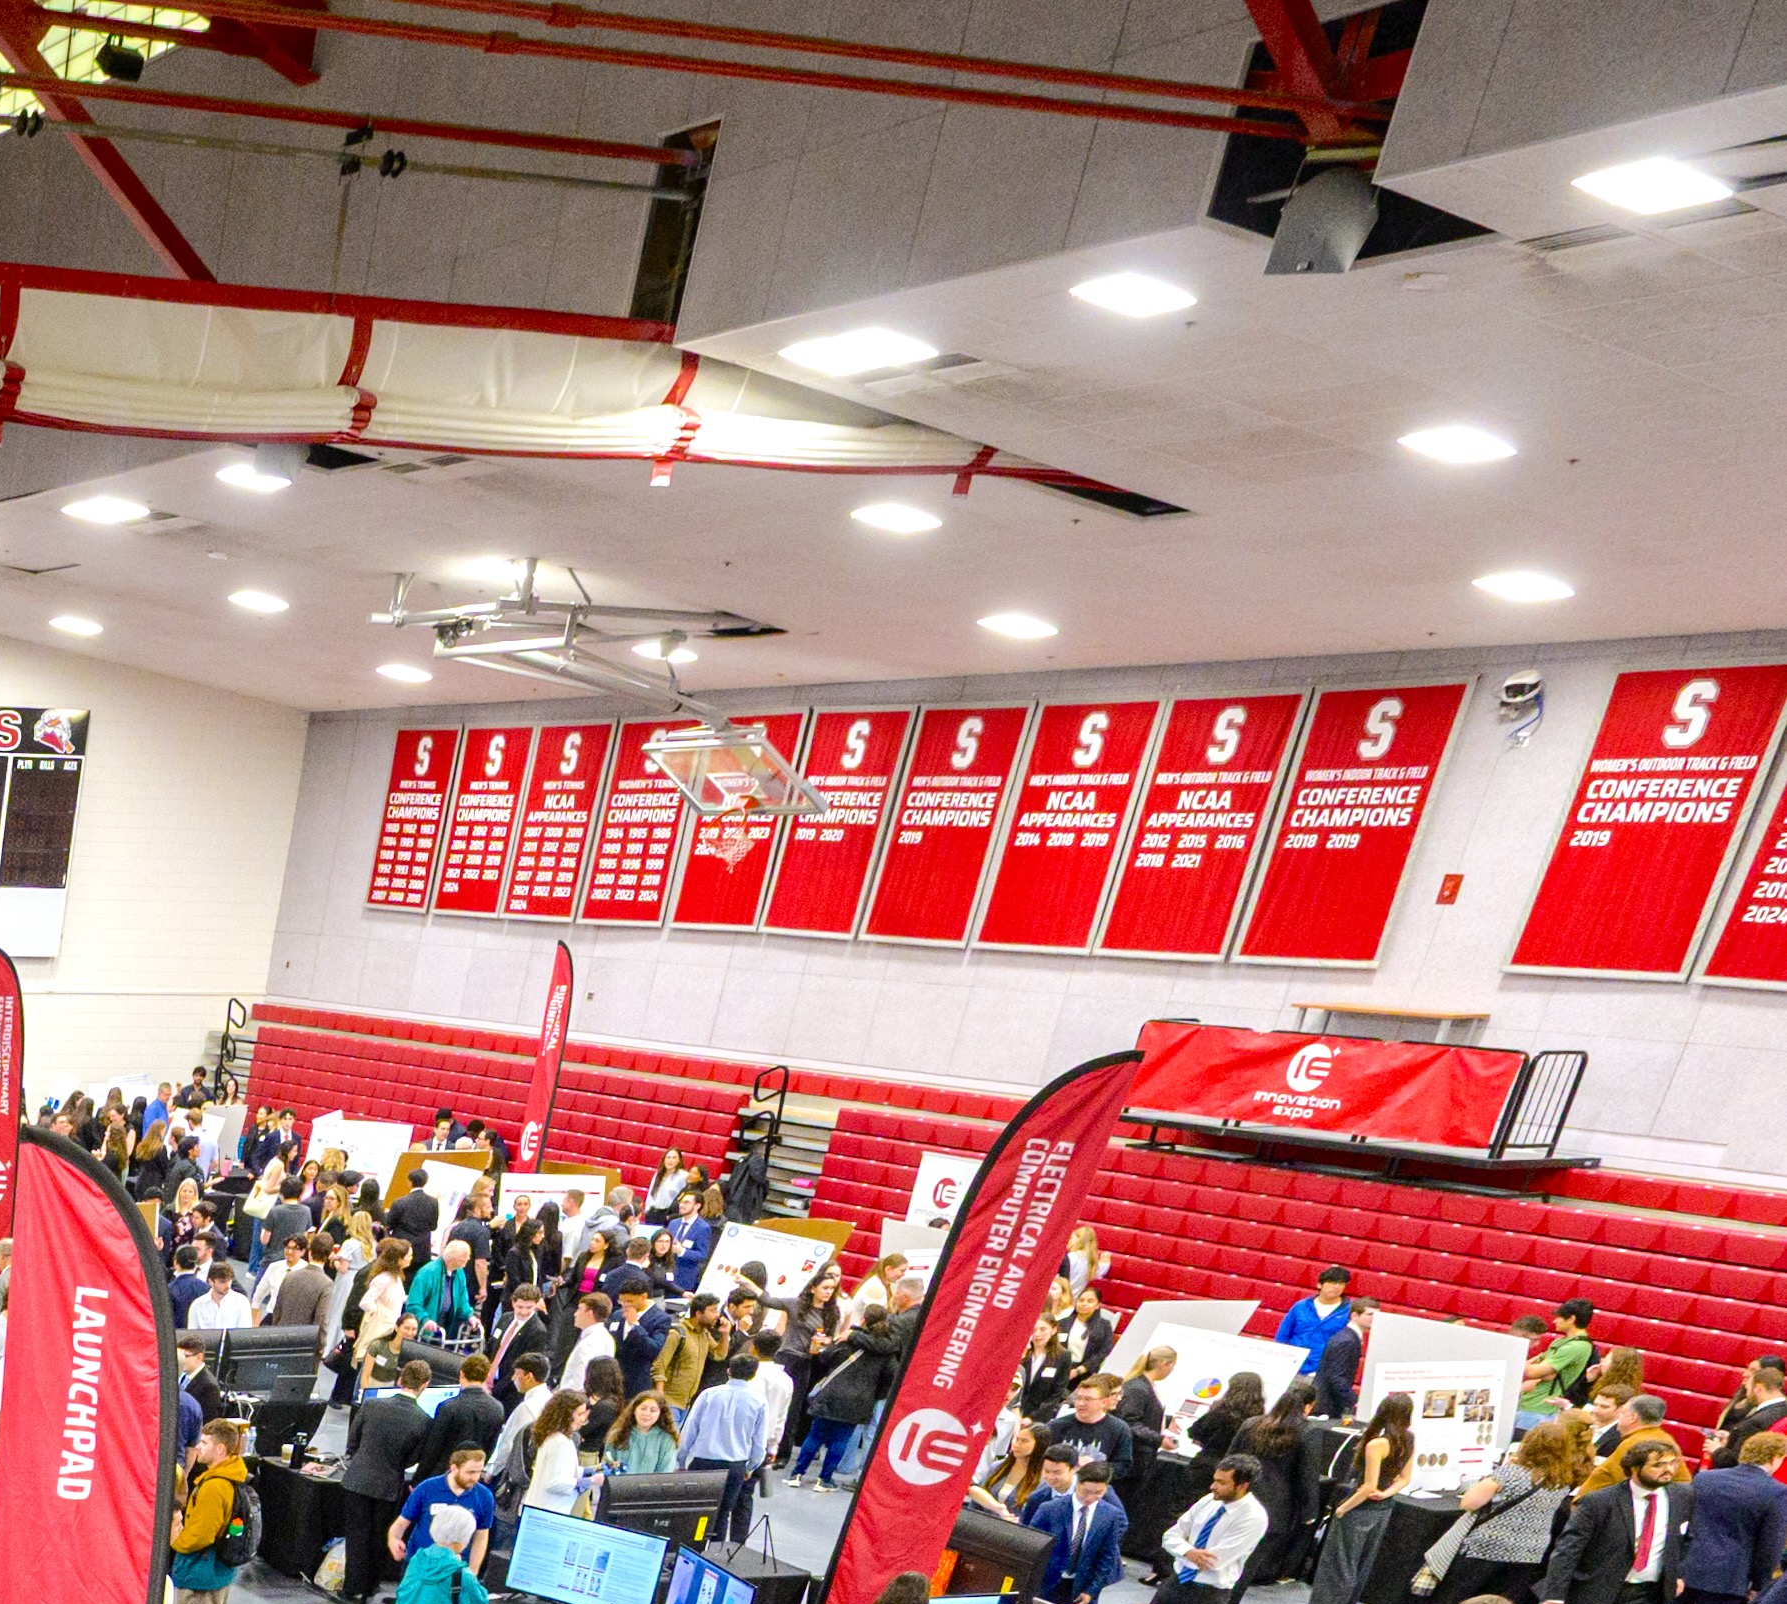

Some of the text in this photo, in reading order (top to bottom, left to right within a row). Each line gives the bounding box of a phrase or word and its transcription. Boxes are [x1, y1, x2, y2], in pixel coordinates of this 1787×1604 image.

[1590, 755, 1758, 773] WOMEN'S OUTDOOR TRACK & FIELD
[1298, 786, 1421, 805] CONFERENCE
[1587, 778, 1742, 799] CONFERENCE
[1291, 807, 1413, 827] CHAMPIONS
[1577, 802, 1732, 822] CHAMPIONS
[1283, 833, 1361, 849] 2018 2019
[1569, 830, 1612, 847] 2019
[0, 996, 13, 1115] INTERDISCIPLINARY
[1253, 1091, 1341, 1110] innovation
[1272, 1105, 1314, 1120] expo
[993, 1141, 1075, 1310] ELECTRICAL AND
[932, 1138, 1050, 1390] COMPUTER ENGINEERING
[57, 1286, 108, 1500] LAUNCHPAD
